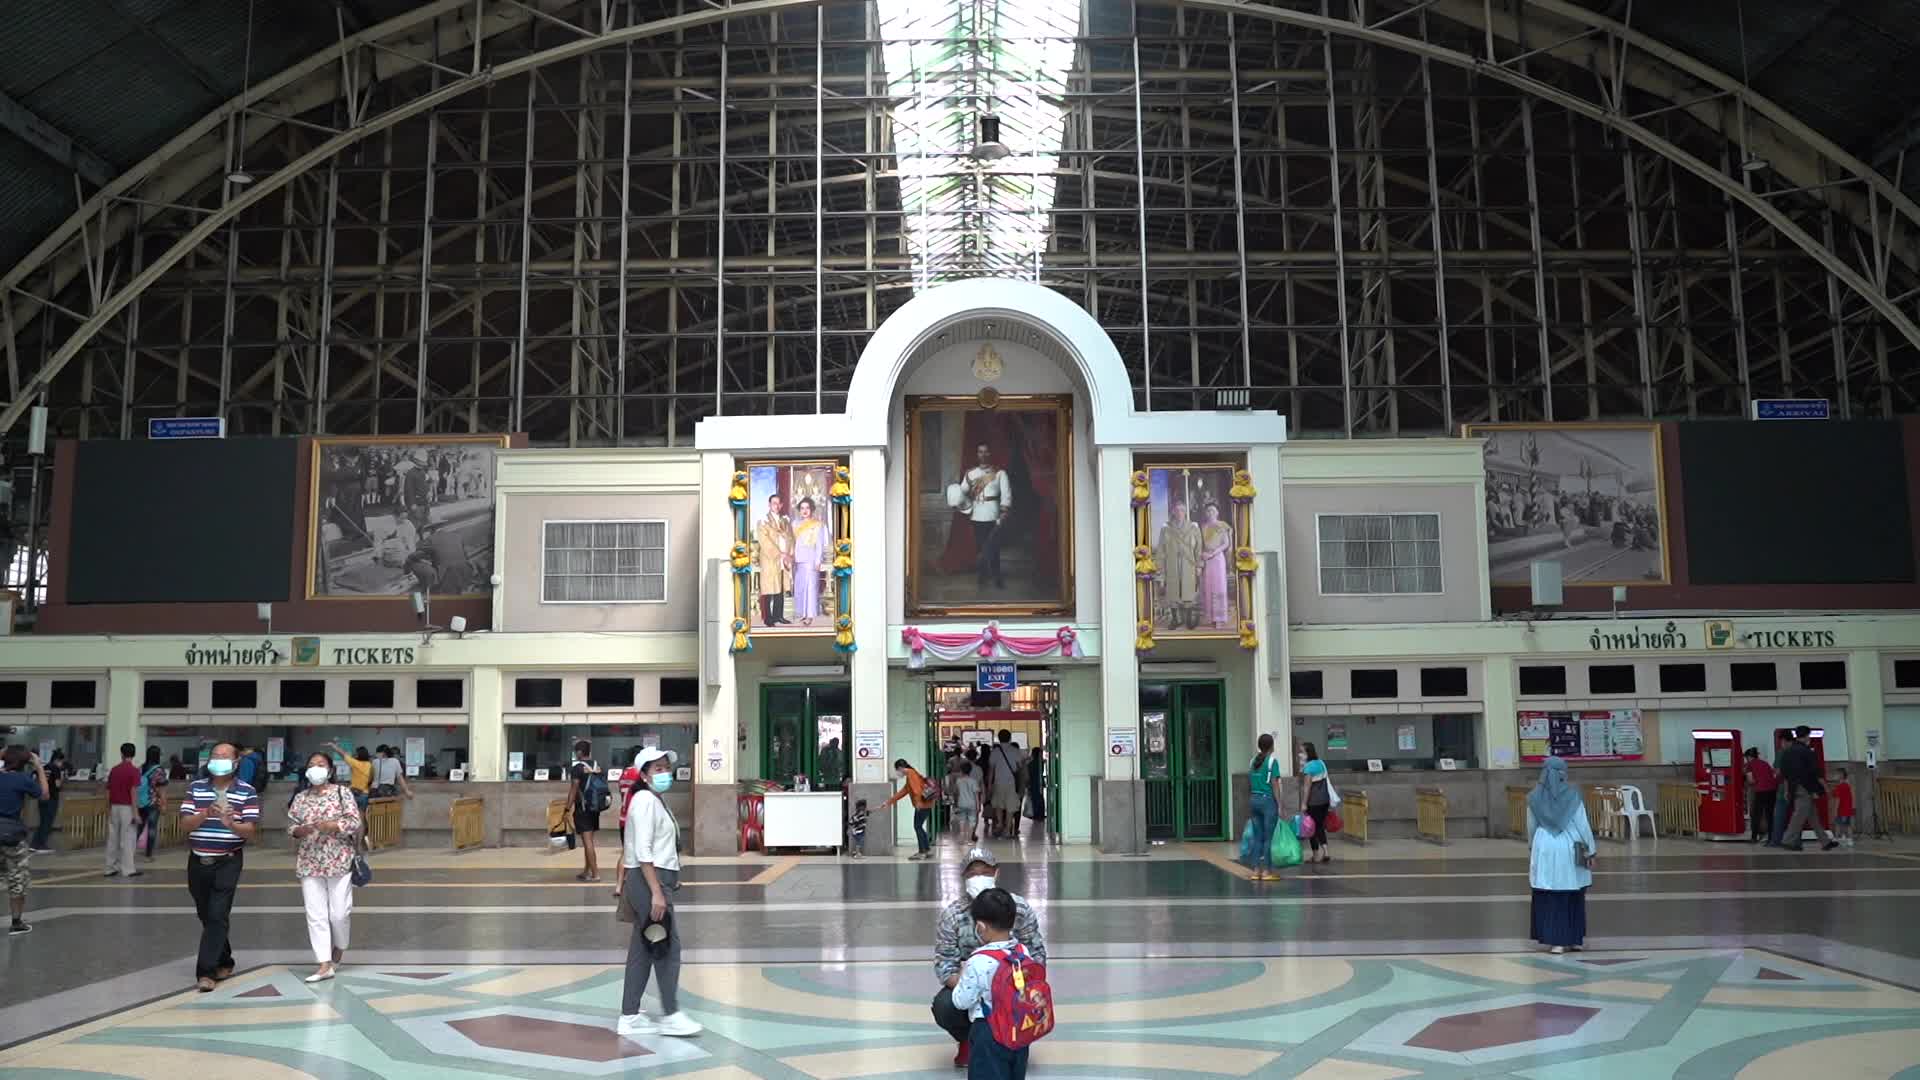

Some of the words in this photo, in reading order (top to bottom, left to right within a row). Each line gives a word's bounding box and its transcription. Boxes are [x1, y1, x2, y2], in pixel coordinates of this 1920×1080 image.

[1589, 621, 1687, 650] จำหน่ายตั๋ว
[1753, 630, 1834, 648] TICKETS
[333, 647, 415, 664] TICKETS
